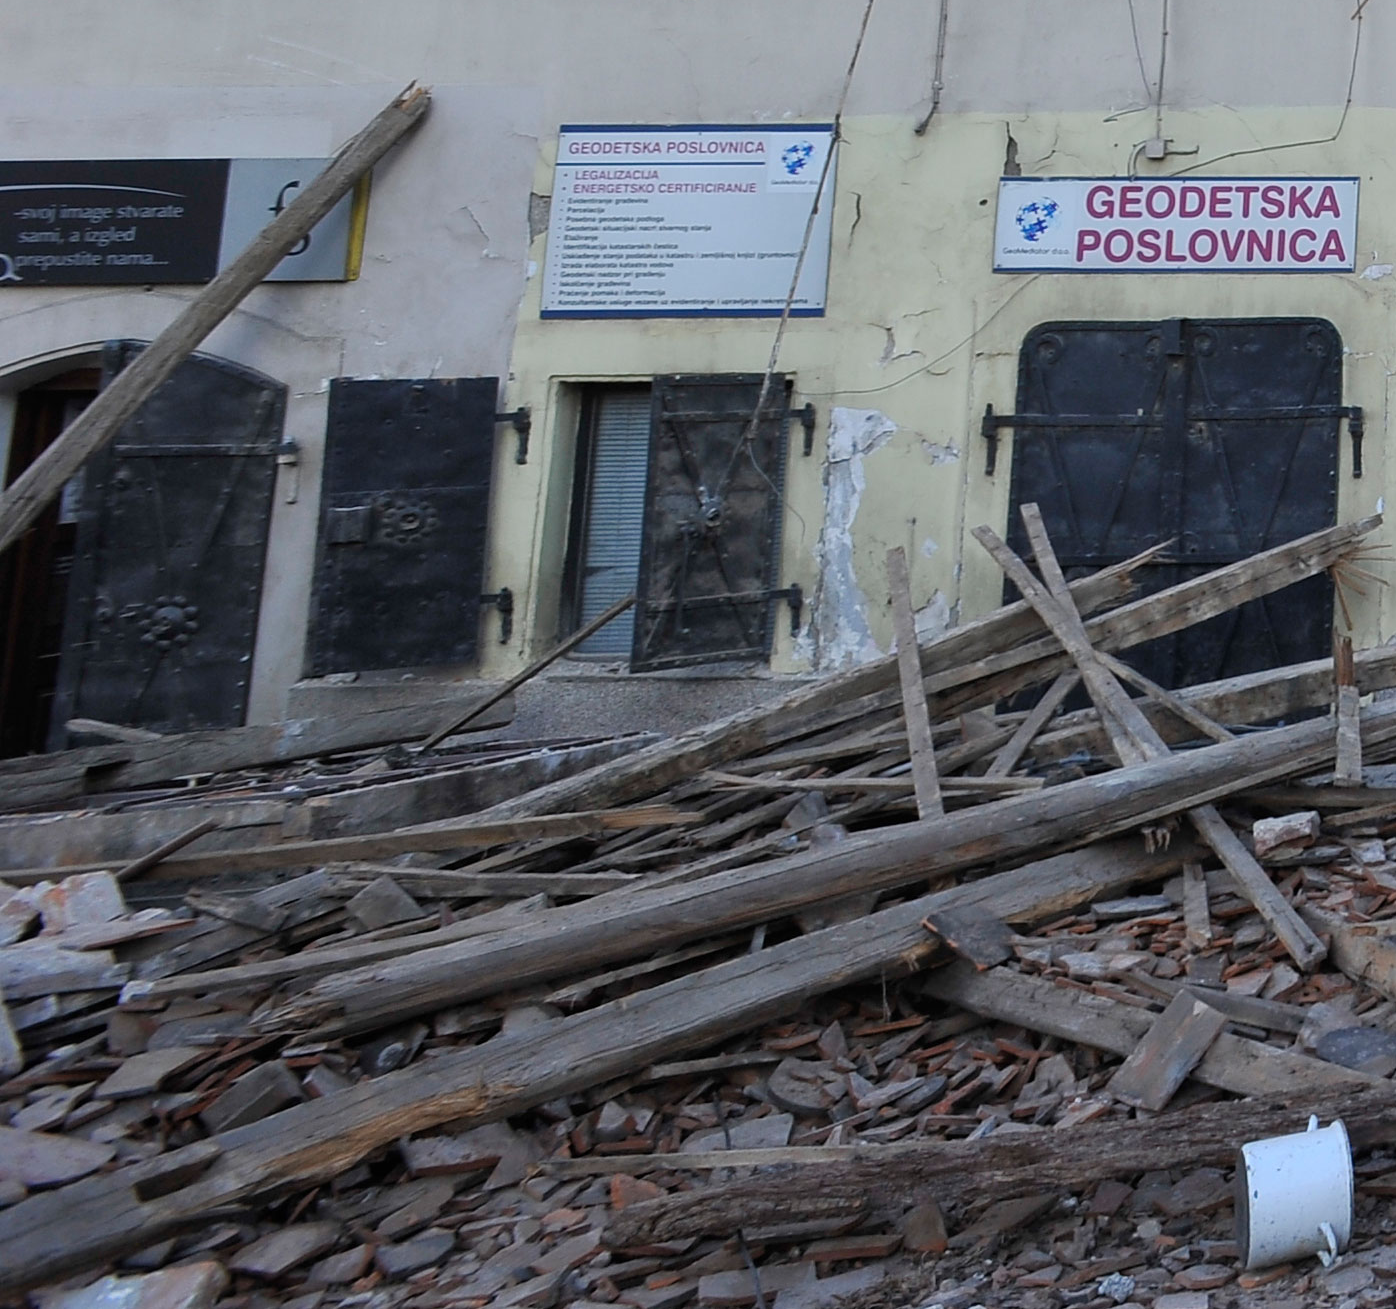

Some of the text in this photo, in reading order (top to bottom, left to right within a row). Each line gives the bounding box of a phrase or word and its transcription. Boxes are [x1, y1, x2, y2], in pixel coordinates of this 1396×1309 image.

[568, 140, 766, 155] GEODETSKA POSLOVNICA
[574, 170, 660, 181] LEGALIZACIJA
[572, 183, 655, 194] ENERGETSKO
[658, 182, 758, 194] CERTIFICIRANJE
[1085, 185, 1341, 219] GEODETSKA
[59, 204, 113, 223] image
[116, 204, 184, 219] stvarate
[18, 226, 137, 247] sami, a izgled
[1076, 229, 1346, 263] POSLOVNICA
[15, 251, 101, 270] prepustite
